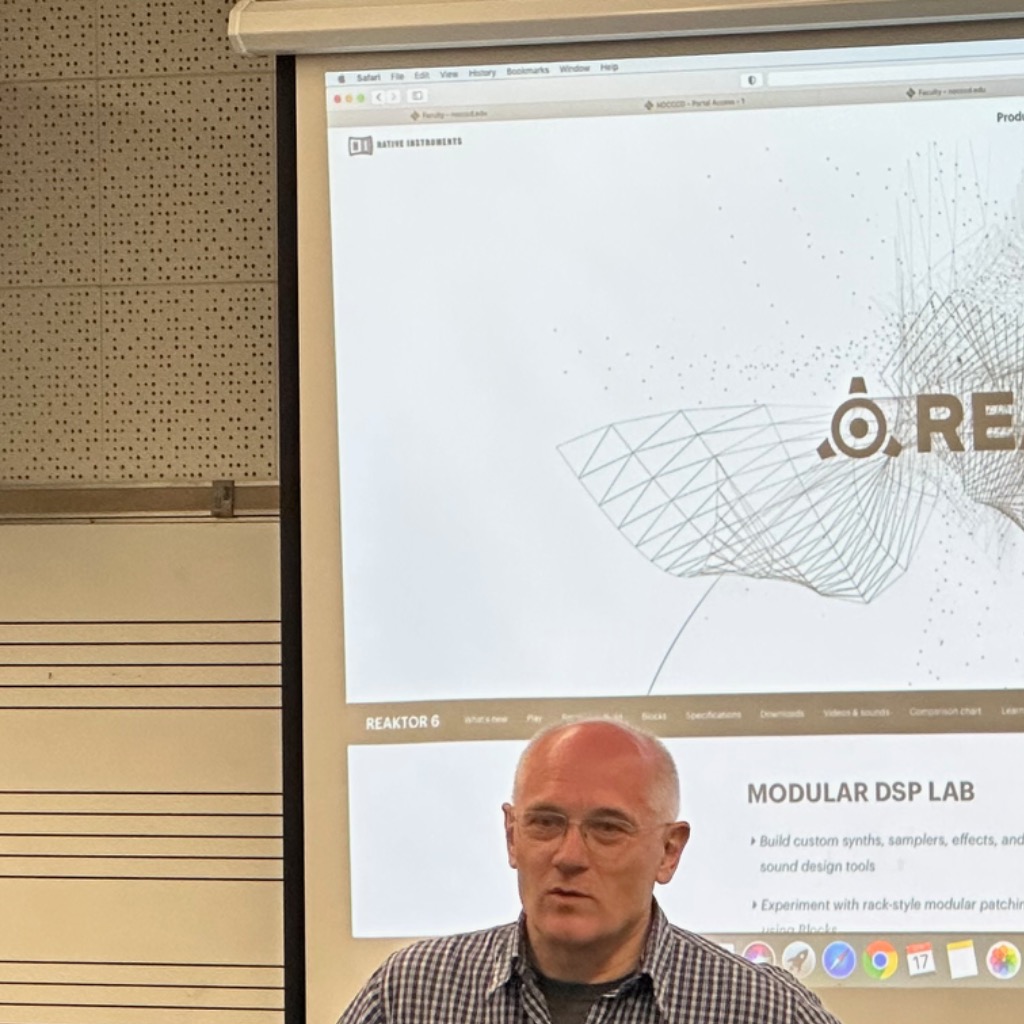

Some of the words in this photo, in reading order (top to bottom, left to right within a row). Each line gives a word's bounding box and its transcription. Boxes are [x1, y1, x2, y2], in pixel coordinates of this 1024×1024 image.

[357, 74, 381, 83] Safari
[390, 72, 405, 81] File
[414, 71, 430, 80] Edit
[440, 70, 459, 79] View
[468, 68, 497, 78] History
[506, 66, 550, 76] Bookmarks
[559, 64, 590, 73] Window
[600, 62, 619, 73] Help
[376, 139, 404, 149] NATIVE
[406, 136, 463, 148] INSTRUMENTS
[366, 715, 429, 730] REAKTOR
[431, 714, 440, 729] 6
[685, 710, 742, 721] Specifications
[759, 709, 805, 719] Downloads
[823, 709, 851, 718] Videos
[860, 708, 891, 718] sounds
[908, 707, 959, 718] Comparison
[960, 706, 982, 717] chart
[747, 782, 869, 804] MODULAR
[875, 781, 922, 802] DSP
[928, 780, 976, 802] LAB
[759, 834, 791, 847] Build
[793, 835, 839, 847] custom
[842, 833, 885, 850] synths,
[888, 833, 949, 849] samplers,
[952, 832, 998, 847] effects,
[759, 860, 798, 873] sound
[801, 859, 843, 875] design
[846, 859, 876, 872] tools
[761, 898, 830, 914] Experiment
[832, 897, 860, 911] with
[862, 897, 922, 912] rack-style
[924, 897, 977, 911] modular
[912, 953, 929, 970] 17
